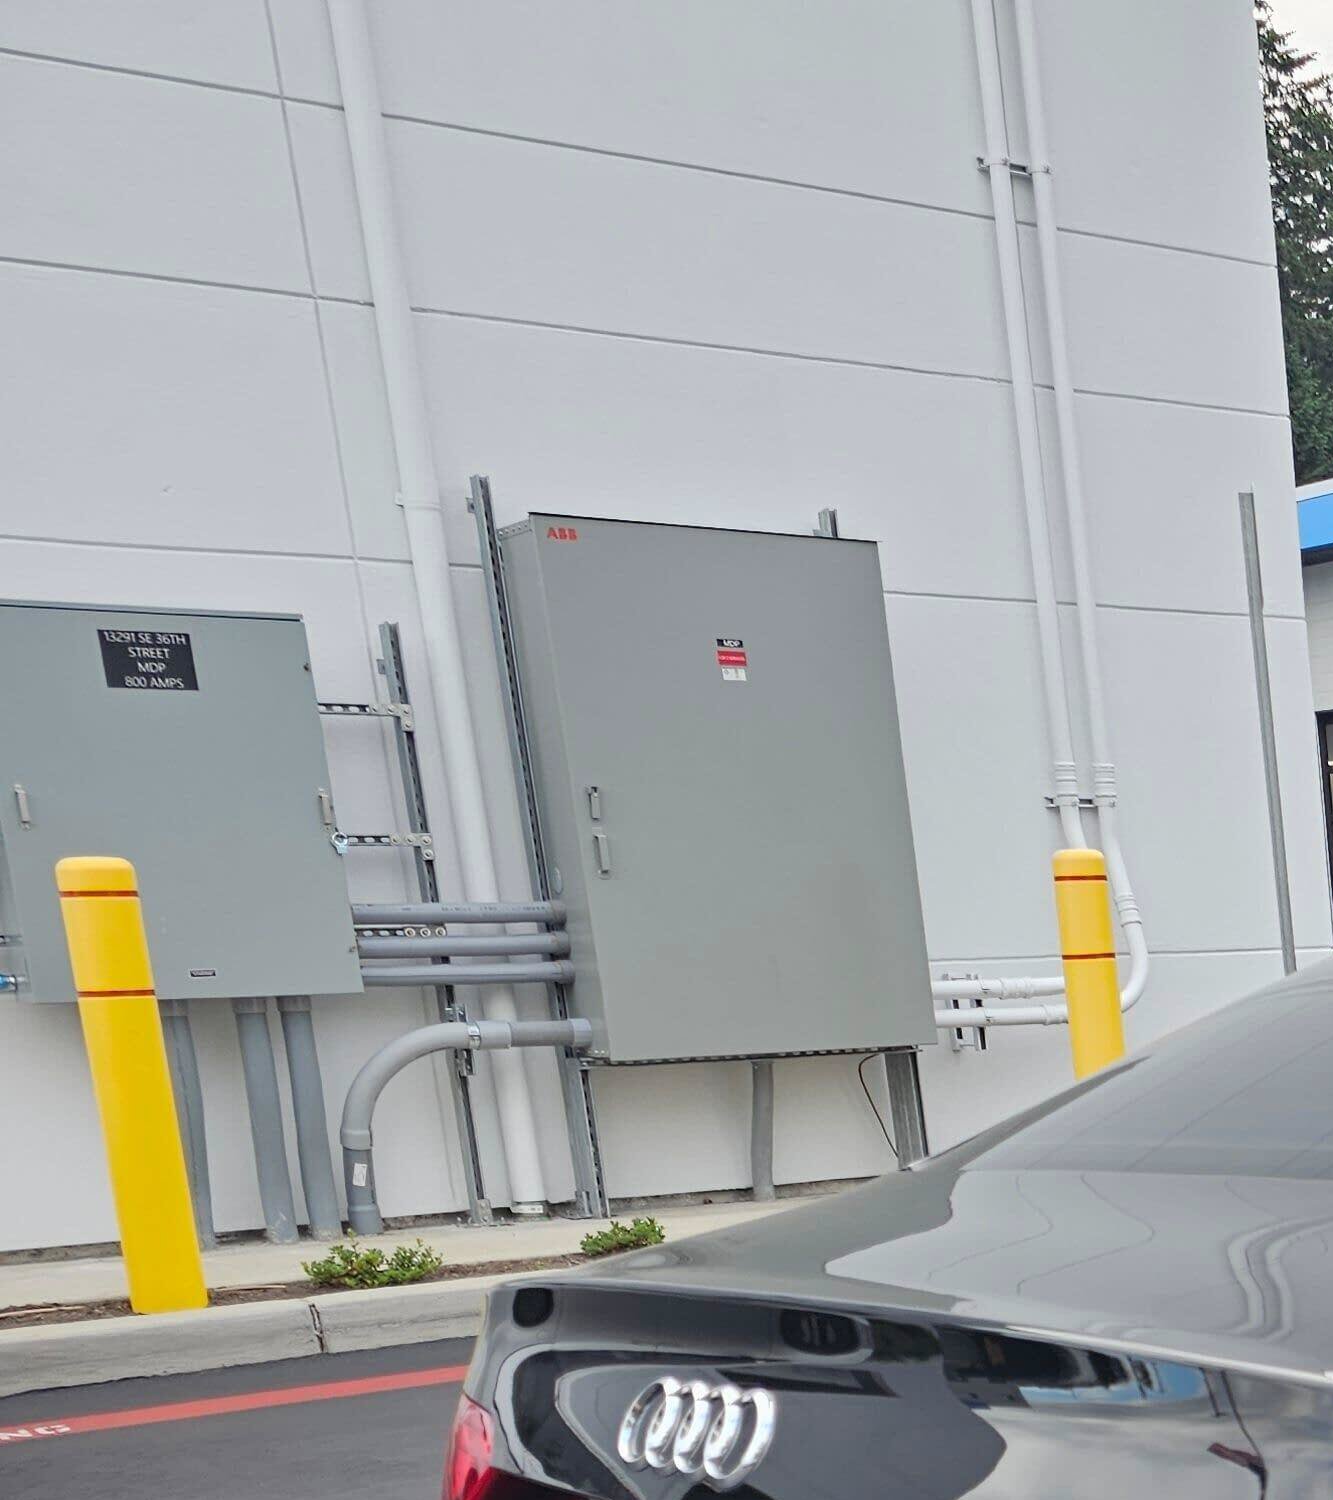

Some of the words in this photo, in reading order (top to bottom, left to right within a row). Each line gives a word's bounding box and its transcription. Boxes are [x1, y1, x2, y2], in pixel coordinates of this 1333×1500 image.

[547, 528, 577, 540] ABB
[103, 631, 136, 644] 13291
[138, 632, 153, 644] SE
[155, 633, 187, 645] 36TH
[127, 646, 170, 659] STREET
[137, 662, 166, 673] MDP
[124, 676, 147, 688] 800
[150, 677, 185, 688] AMPS
